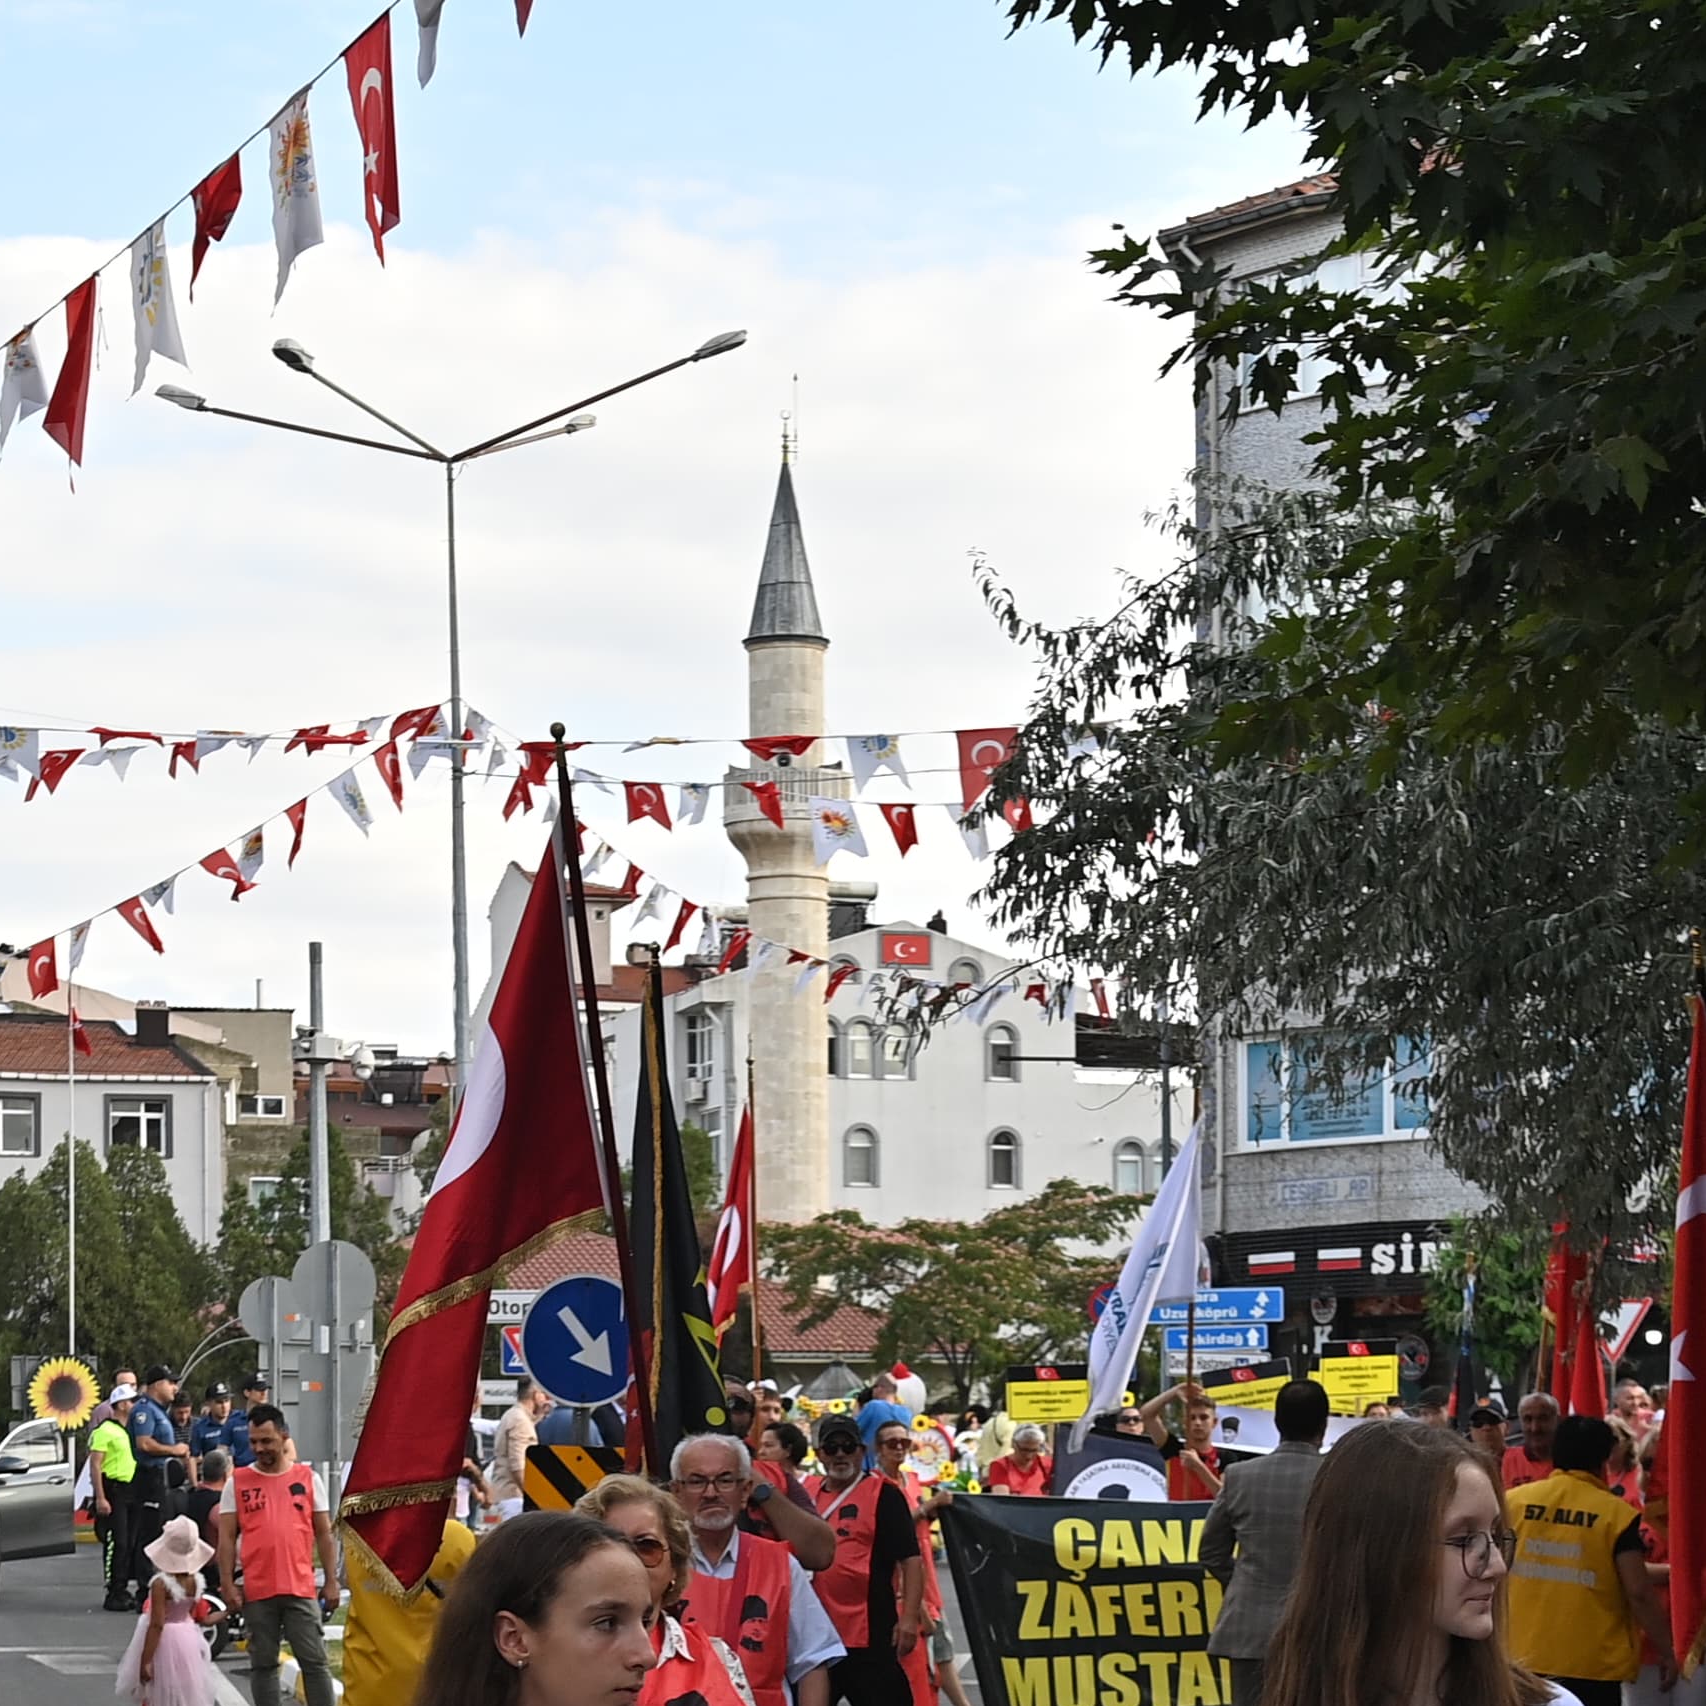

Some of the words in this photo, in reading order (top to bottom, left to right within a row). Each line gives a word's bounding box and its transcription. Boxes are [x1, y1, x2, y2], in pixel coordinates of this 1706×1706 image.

[1159, 1306, 1239, 1320] Uzuköprü
[1178, 1332, 1244, 1347] Tkirdağ
[1524, 1503, 1550, 1522] 57.
[1552, 1507, 1601, 1529] ALAY
